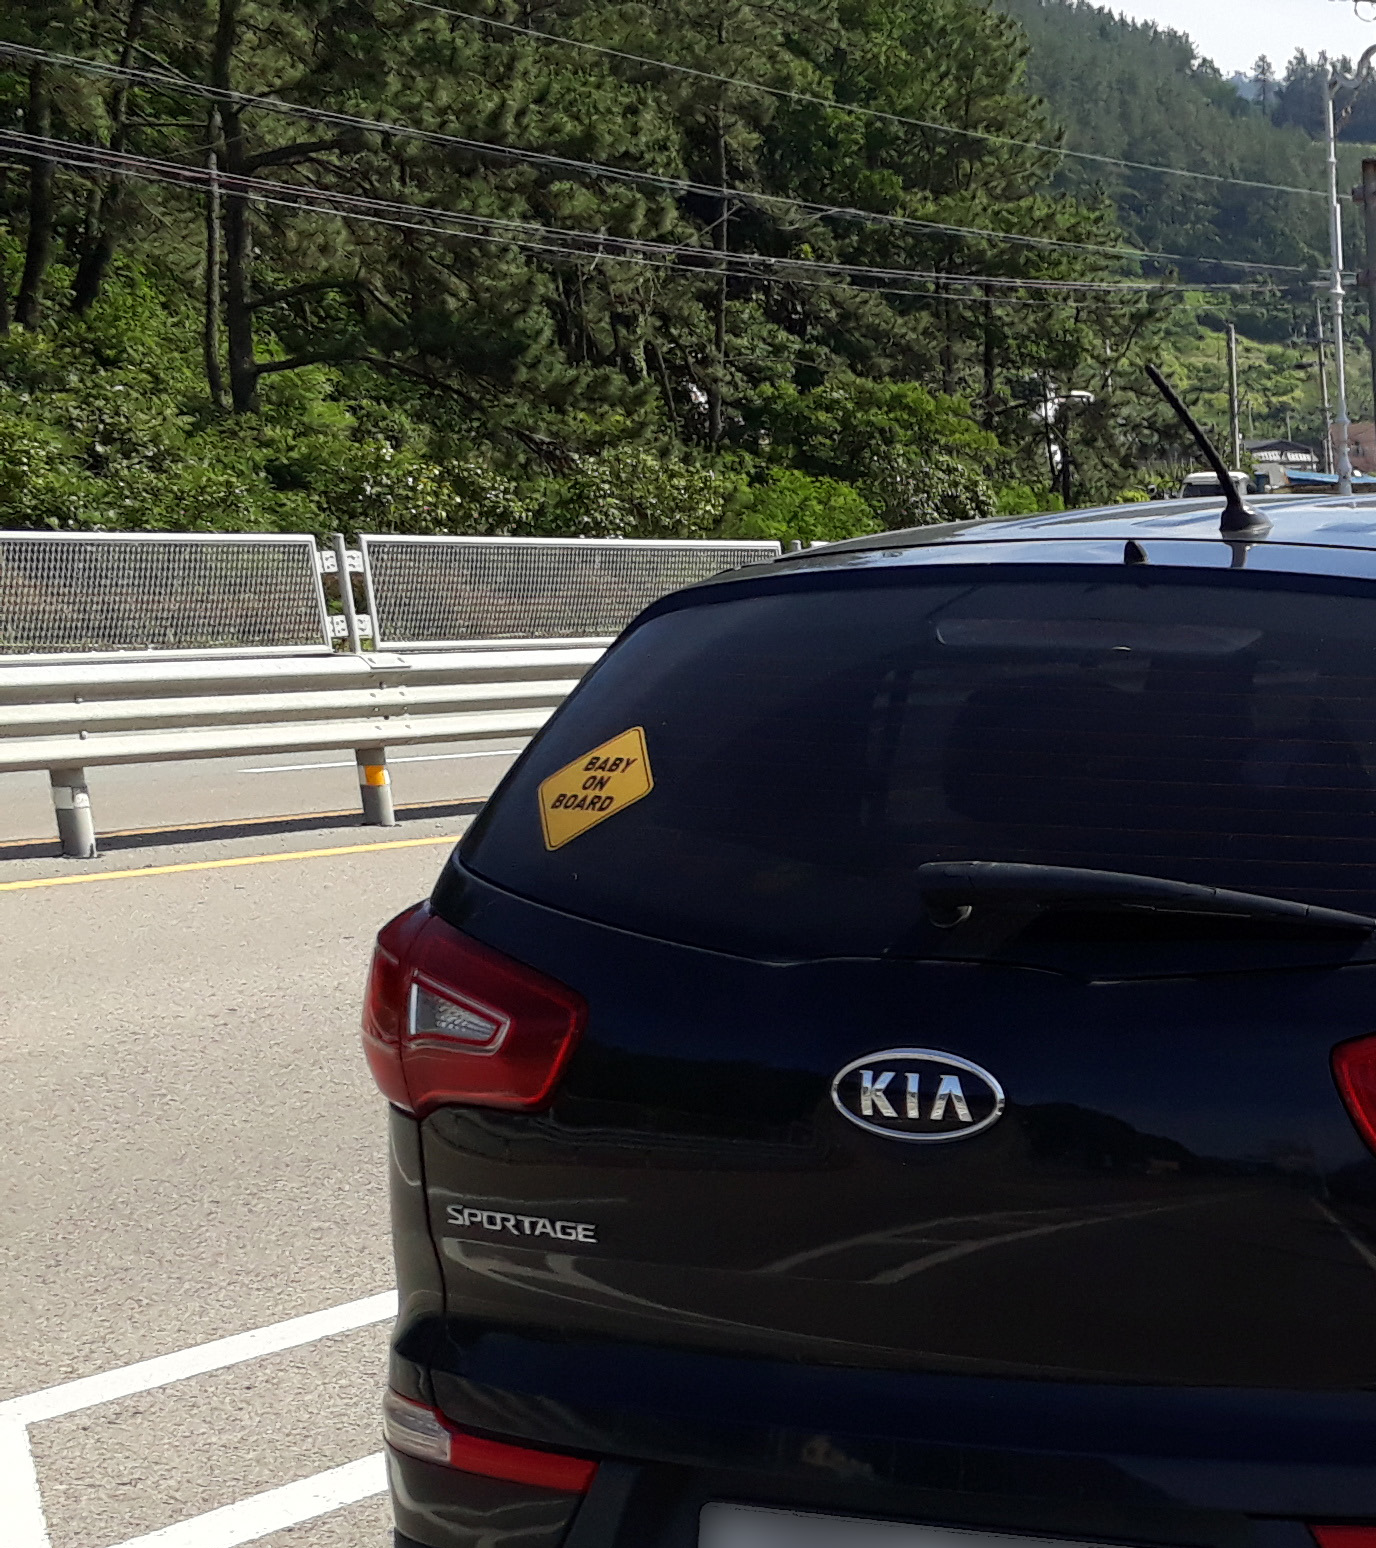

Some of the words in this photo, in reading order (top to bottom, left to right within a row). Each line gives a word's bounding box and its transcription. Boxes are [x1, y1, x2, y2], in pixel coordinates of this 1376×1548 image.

[583, 756, 638, 773] BABY
[582, 775, 611, 791] ON
[551, 793, 615, 812] BOARD
[858, 1069, 973, 1122] KIA
[446, 1205, 597, 1243] SPORTAGE
